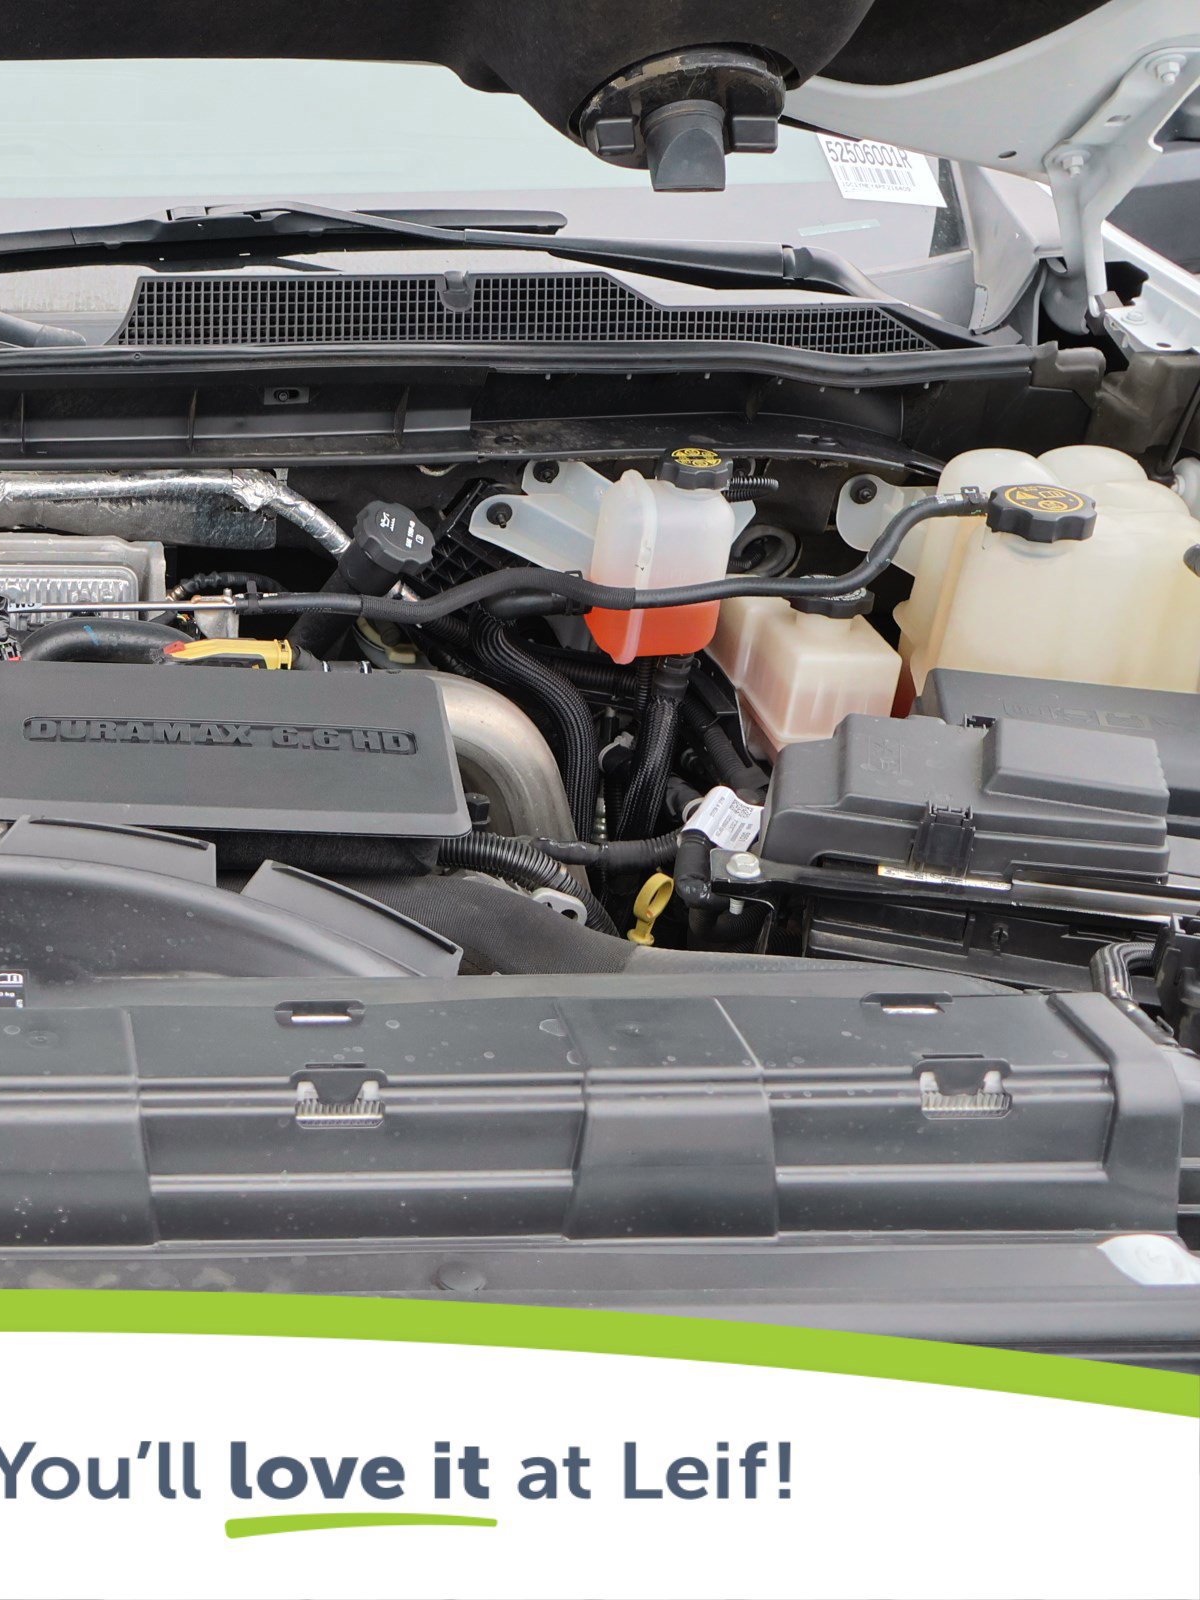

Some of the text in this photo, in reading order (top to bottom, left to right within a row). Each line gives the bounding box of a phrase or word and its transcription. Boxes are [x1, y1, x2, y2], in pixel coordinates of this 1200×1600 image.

[826, 141, 912, 169] 52506001R
[29, 719, 417, 755] DURAMAX 6.6 HD
